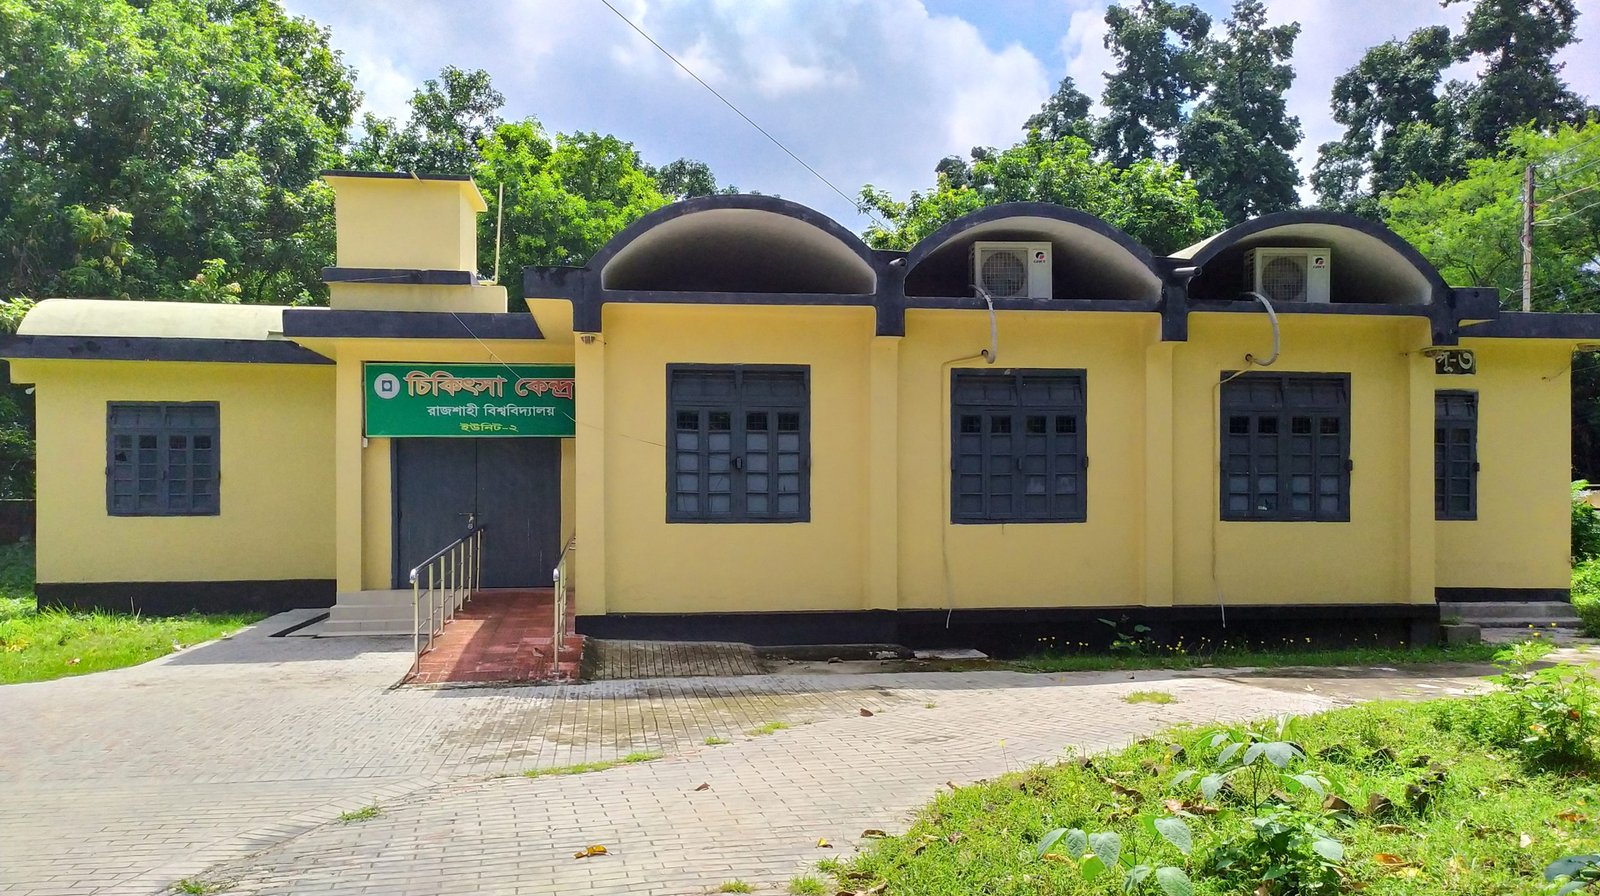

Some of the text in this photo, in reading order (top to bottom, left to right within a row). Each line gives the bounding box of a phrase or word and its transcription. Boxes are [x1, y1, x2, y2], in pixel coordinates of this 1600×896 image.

[403, 370, 575, 399] চিকিৎসা কেন্দ্র
[427, 403, 556, 418] রাজশাহী বিশ্ববিদ্যালয়
[459, 422, 519, 433] ইউনিট-২
